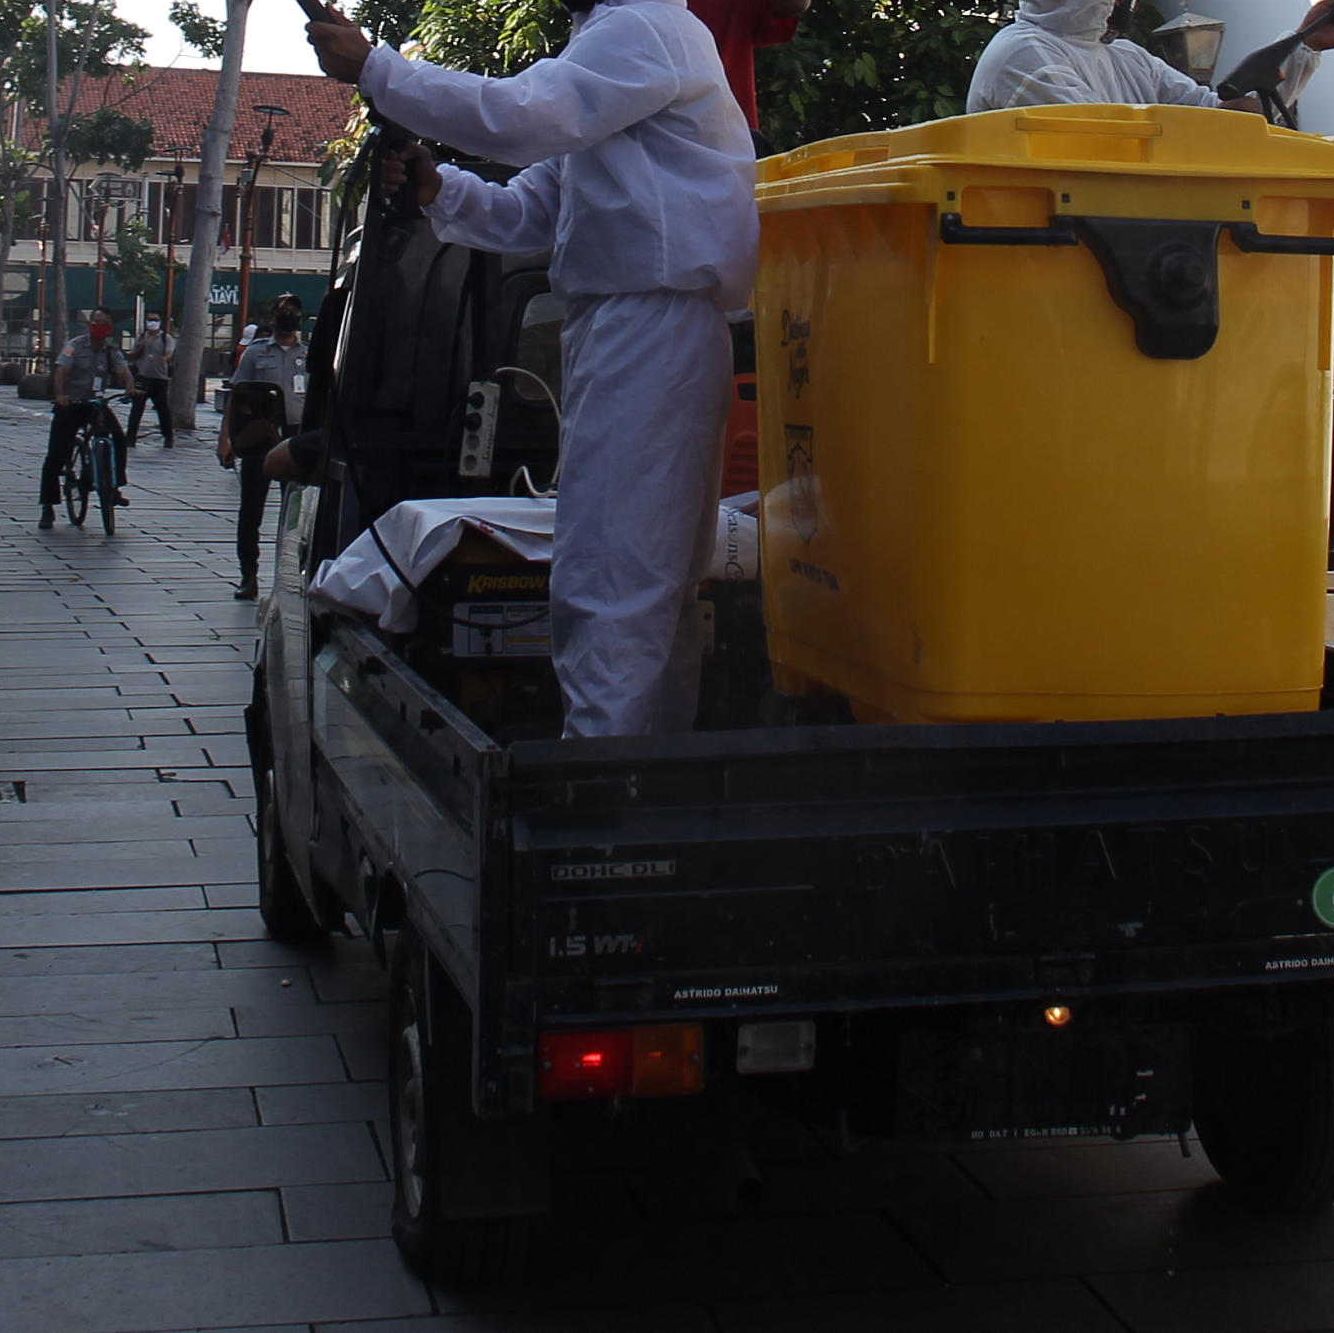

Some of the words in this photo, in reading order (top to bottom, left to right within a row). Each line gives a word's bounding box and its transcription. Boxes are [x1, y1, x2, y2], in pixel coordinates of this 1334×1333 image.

[468, 572, 548, 594] KRISBOW
[549, 935, 587, 957] 1.5
[1265, 958, 1308, 971] ASTRIDO
[674, 988, 721, 1001] ASTRIDO
[724, 984, 779, 998] DAIHATSU
